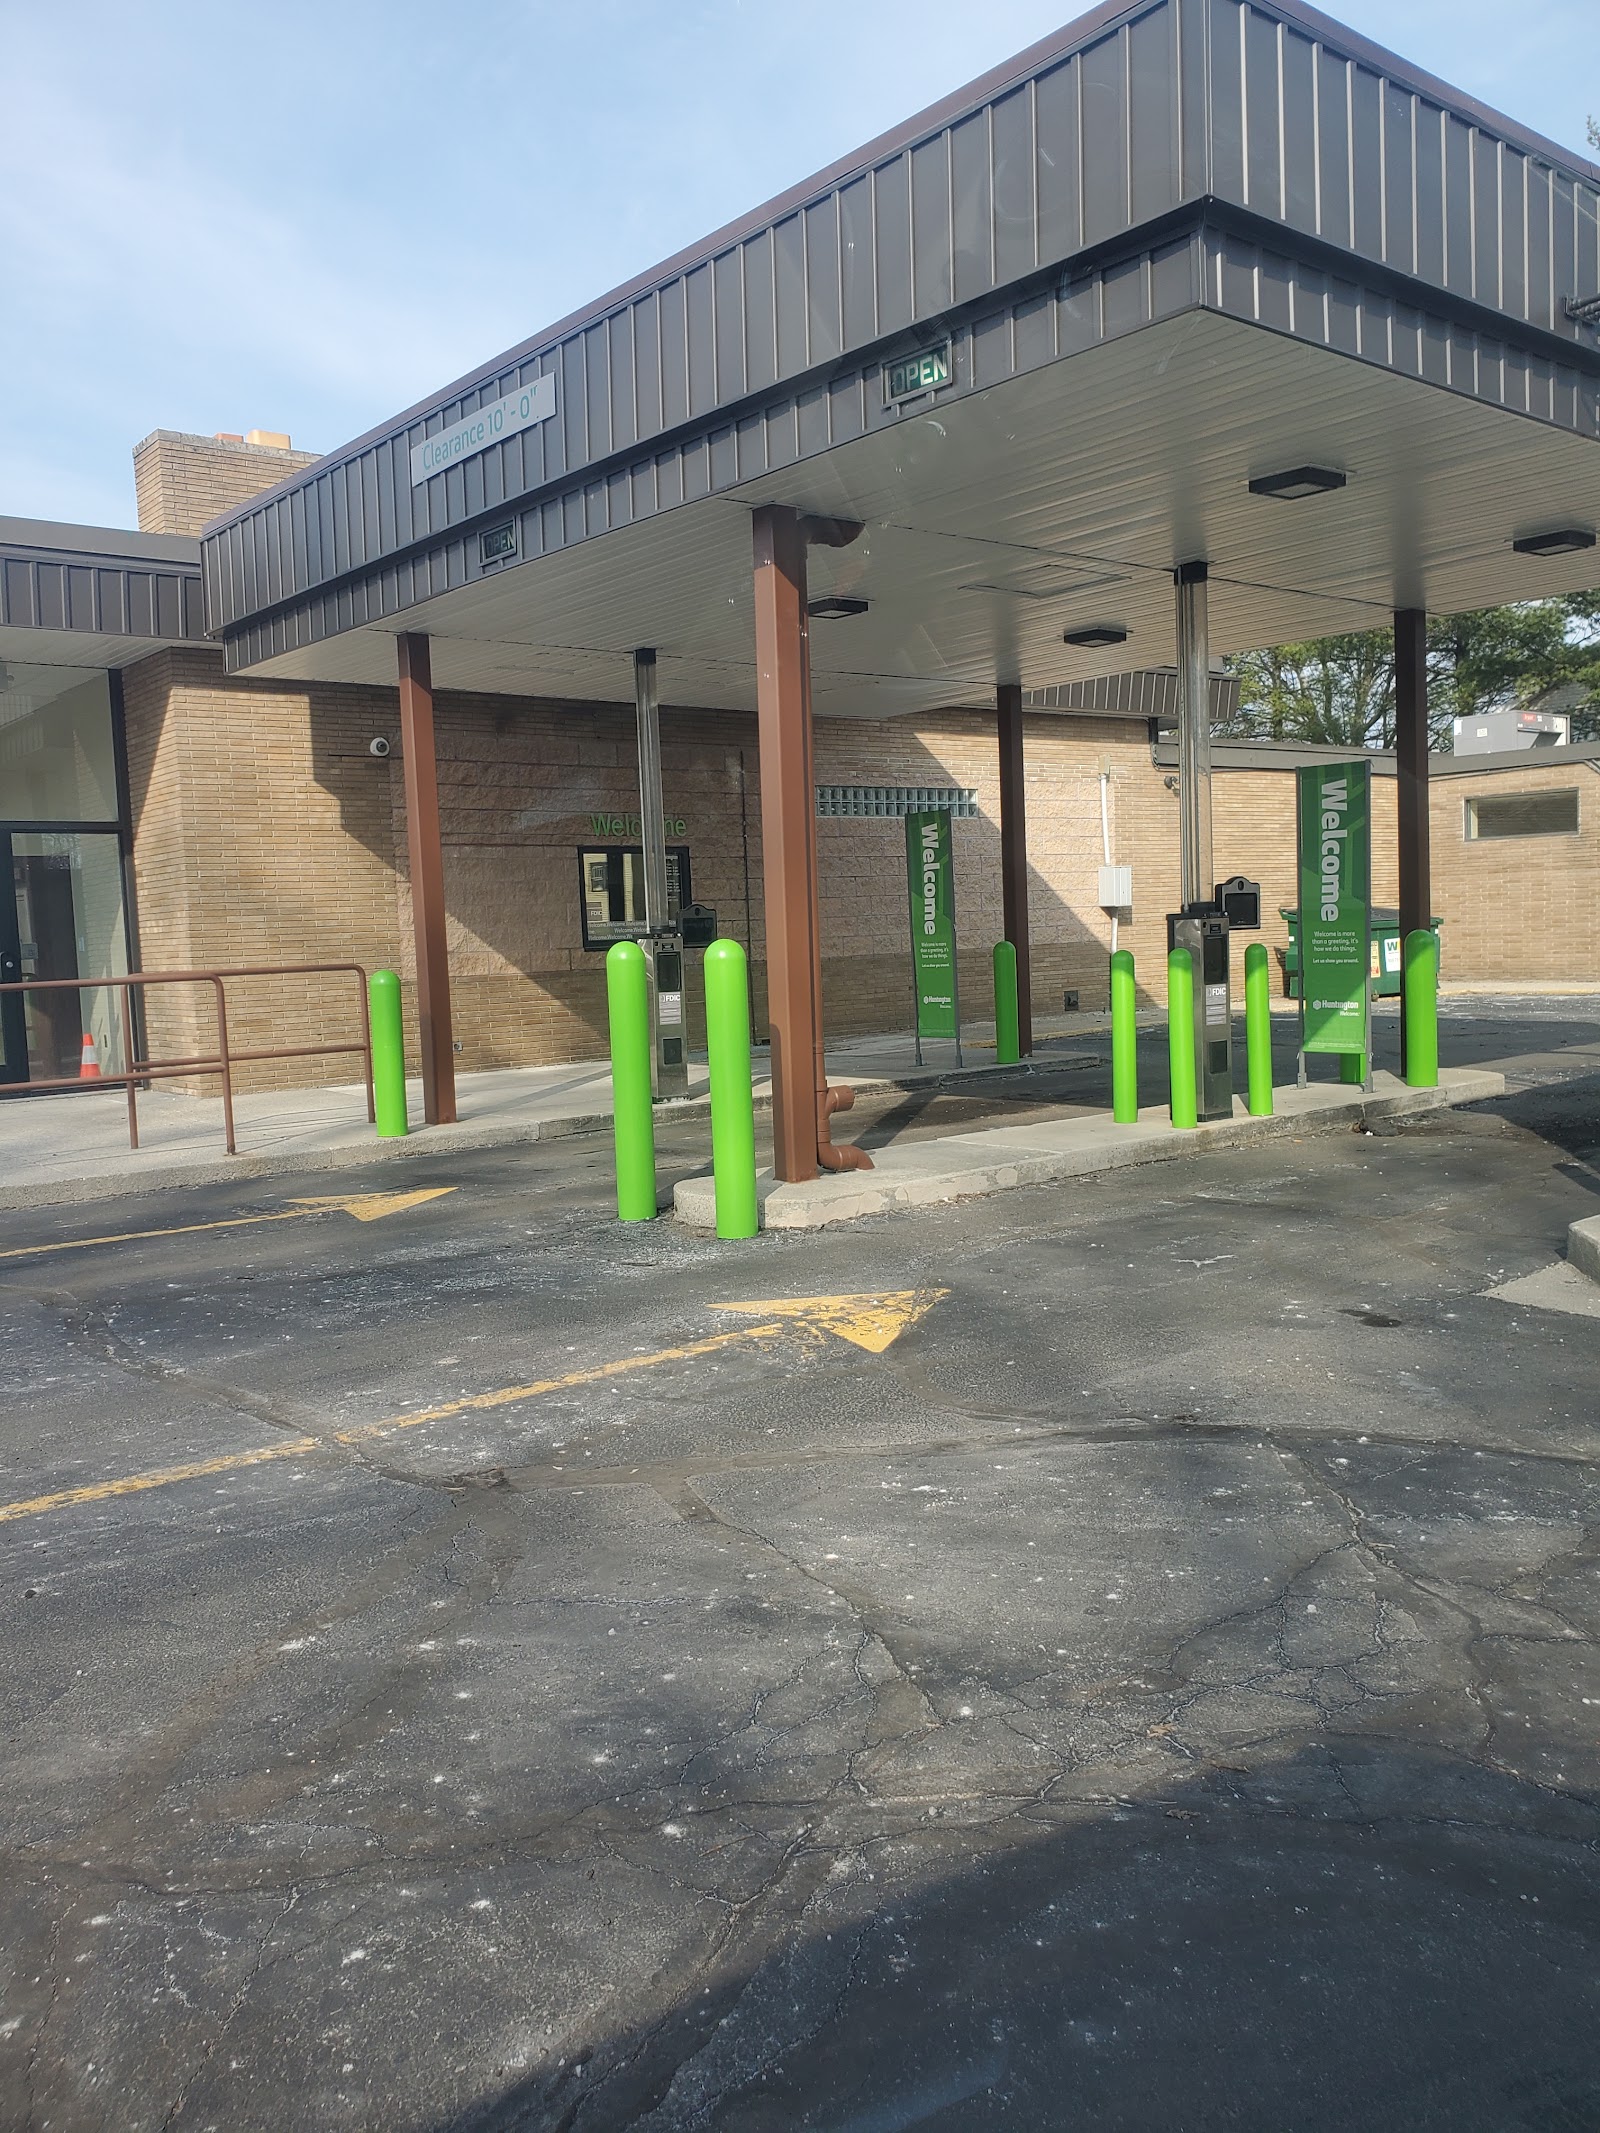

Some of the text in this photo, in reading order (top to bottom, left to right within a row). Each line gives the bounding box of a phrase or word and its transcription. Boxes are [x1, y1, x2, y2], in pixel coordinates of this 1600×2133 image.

[892, 350, 948, 394] OPEN
[423, 422, 485, 471] Clearance
[486, 530, 515, 556] OPEN
[590, 812, 687, 837] Welcme
[1321, 778, 1348, 922] Welcome
[921, 822, 941, 935] Welcome
[665, 994, 681, 1003] FDIC
[1212, 987, 1226, 996] FDIC
[1321, 999, 1359, 1011] Huntington
